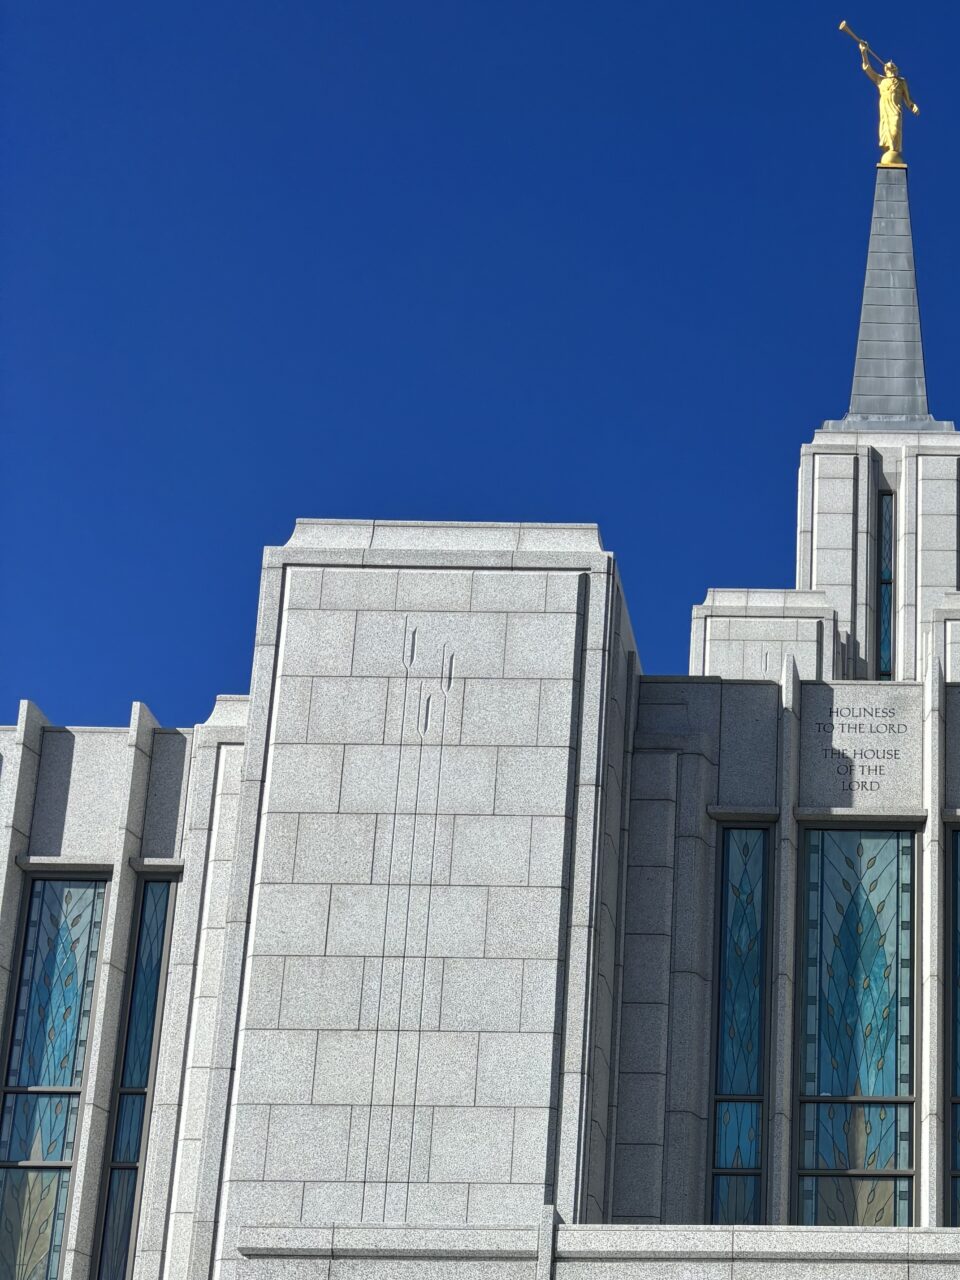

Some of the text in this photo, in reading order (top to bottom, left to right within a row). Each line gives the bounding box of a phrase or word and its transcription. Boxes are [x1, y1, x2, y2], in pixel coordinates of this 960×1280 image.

[829, 707, 896, 718] HOLINESS
[815, 722, 908, 734] TO THE LORD
[823, 748, 901, 760] THE HOUSE
[837, 764, 885, 776] OF THE
[842, 781, 880, 791] LORD
